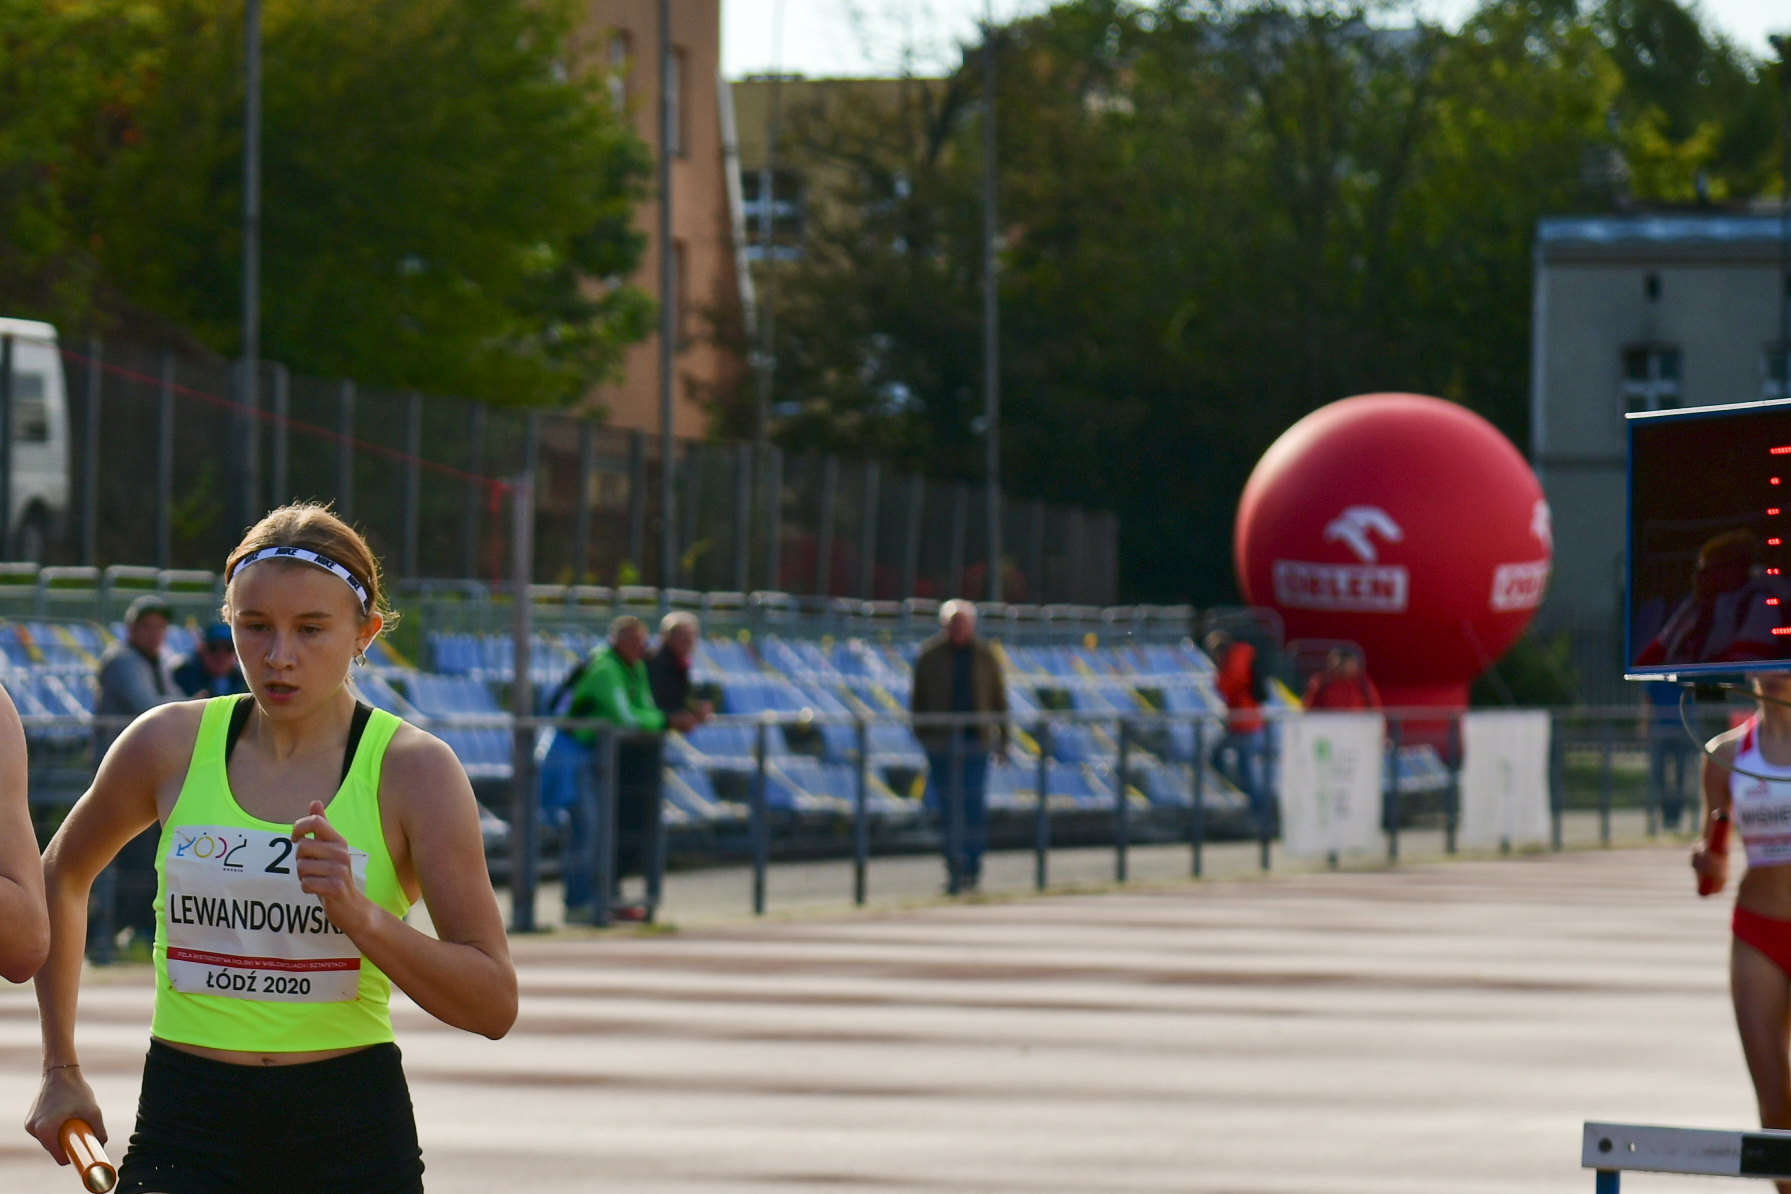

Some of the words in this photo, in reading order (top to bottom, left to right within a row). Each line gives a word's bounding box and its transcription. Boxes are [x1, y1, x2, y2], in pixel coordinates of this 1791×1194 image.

[275, 547, 299, 556] NIKE
[314, 555, 336, 570] NIKE
[346, 574, 362, 592] NIKE
[170, 894, 344, 934] LEWANDOWS
[206, 968, 257, 992] ŁÓDŹ
[263, 976, 310, 995] 2020
